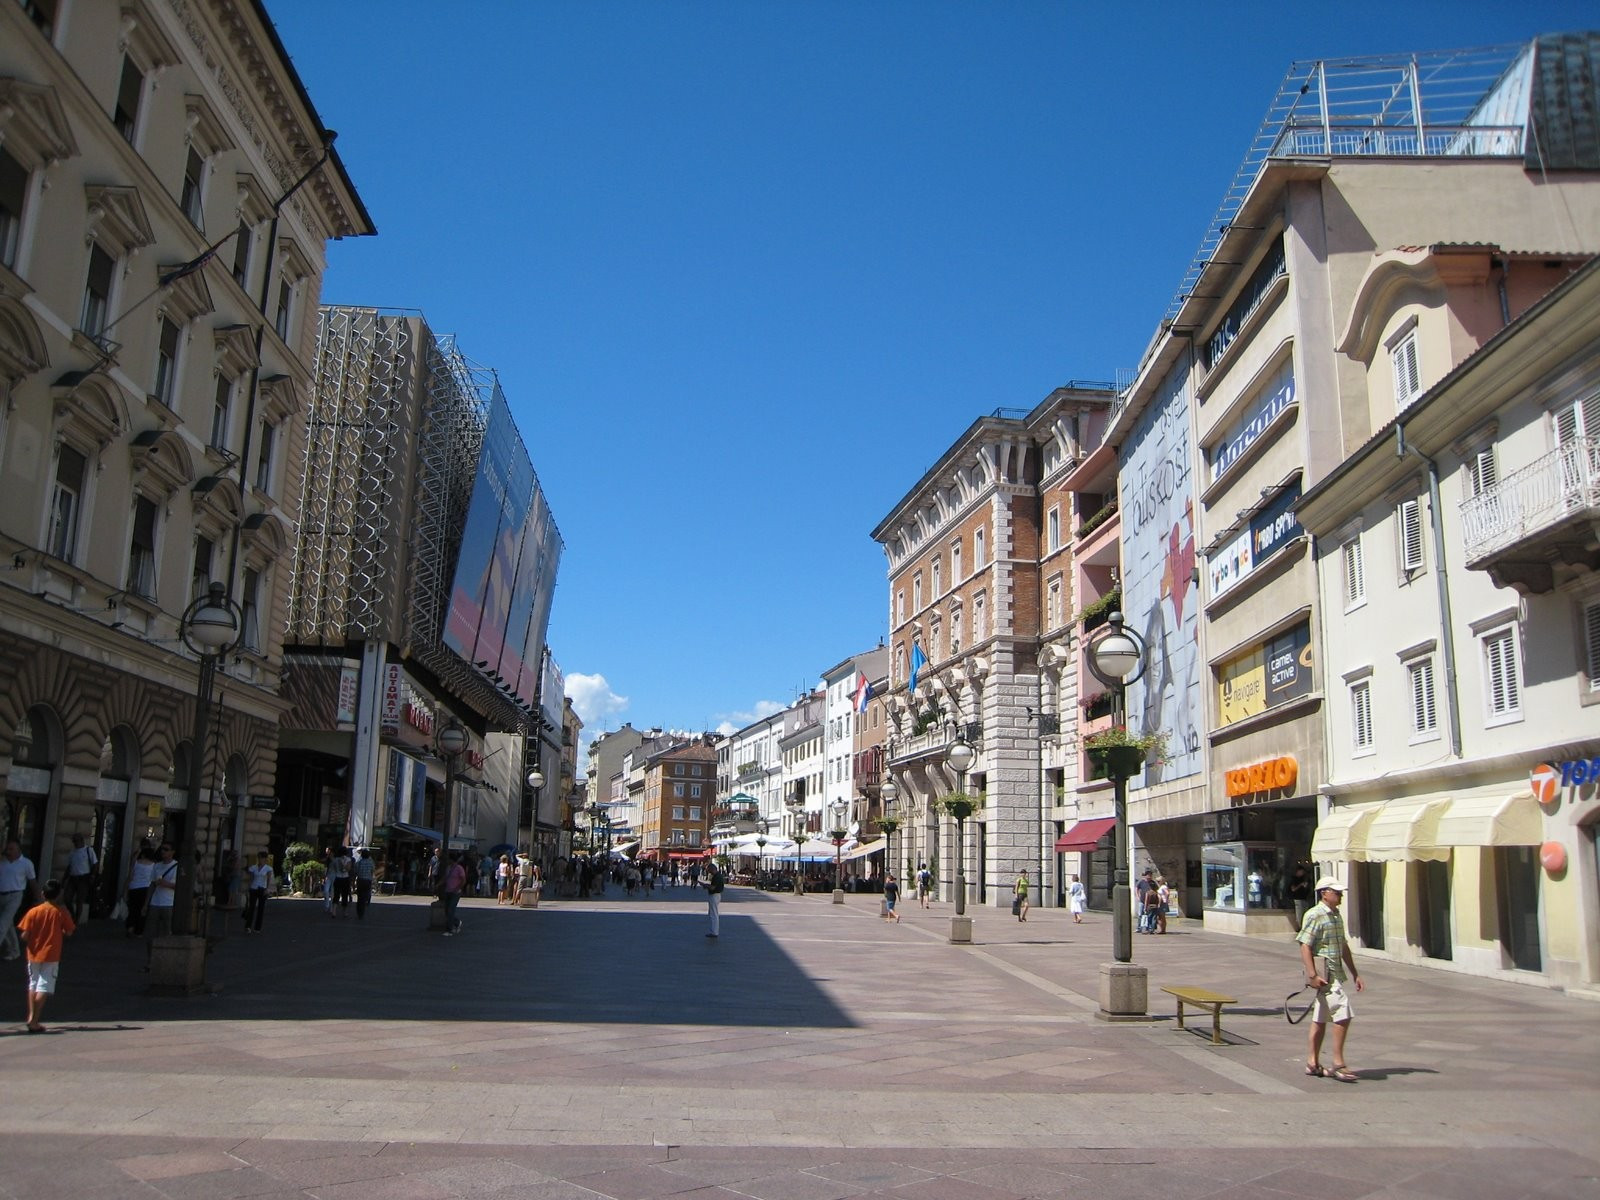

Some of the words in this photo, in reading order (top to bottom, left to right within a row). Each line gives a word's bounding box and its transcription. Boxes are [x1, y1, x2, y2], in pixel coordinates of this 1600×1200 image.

[1271, 652, 1294, 671] camel
[1271, 666, 1295, 685] active
[386, 665, 398, 713] AUTOMAT
[1233, 680, 1260, 703] navigare
[1224, 757, 1297, 797] KORZO
